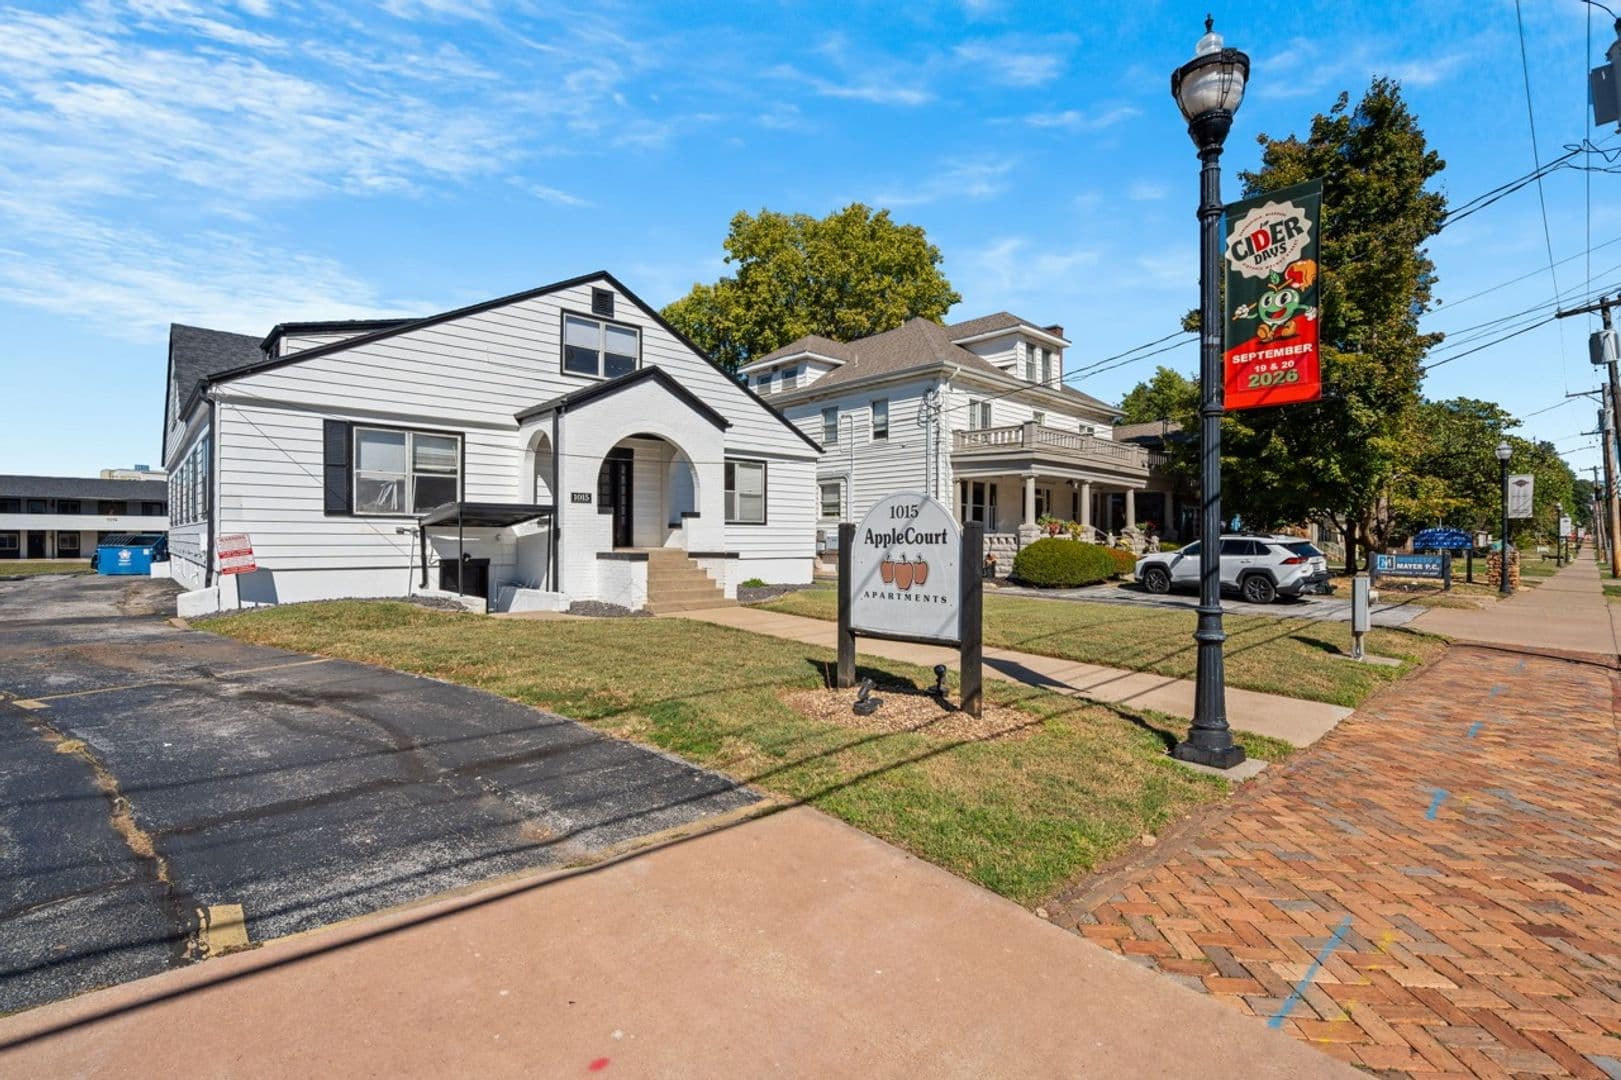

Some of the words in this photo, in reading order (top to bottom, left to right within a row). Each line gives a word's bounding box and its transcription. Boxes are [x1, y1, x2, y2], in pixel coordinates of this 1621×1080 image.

[1231, 216, 1305, 262] CIDER
[1254, 242, 1287, 265] DAYS
[1232, 343, 1313, 364] SEPTEMBER
[1254, 364, 1267, 373] 19
[1270, 362, 1278, 371] &
[1281, 359, 1295, 369] 20
[1248, 368, 1299, 389] 2026
[890, 504, 919, 519] 1015
[865, 527, 947, 548] AppleCourt
[864, 591, 948, 604] APARTMENTS
